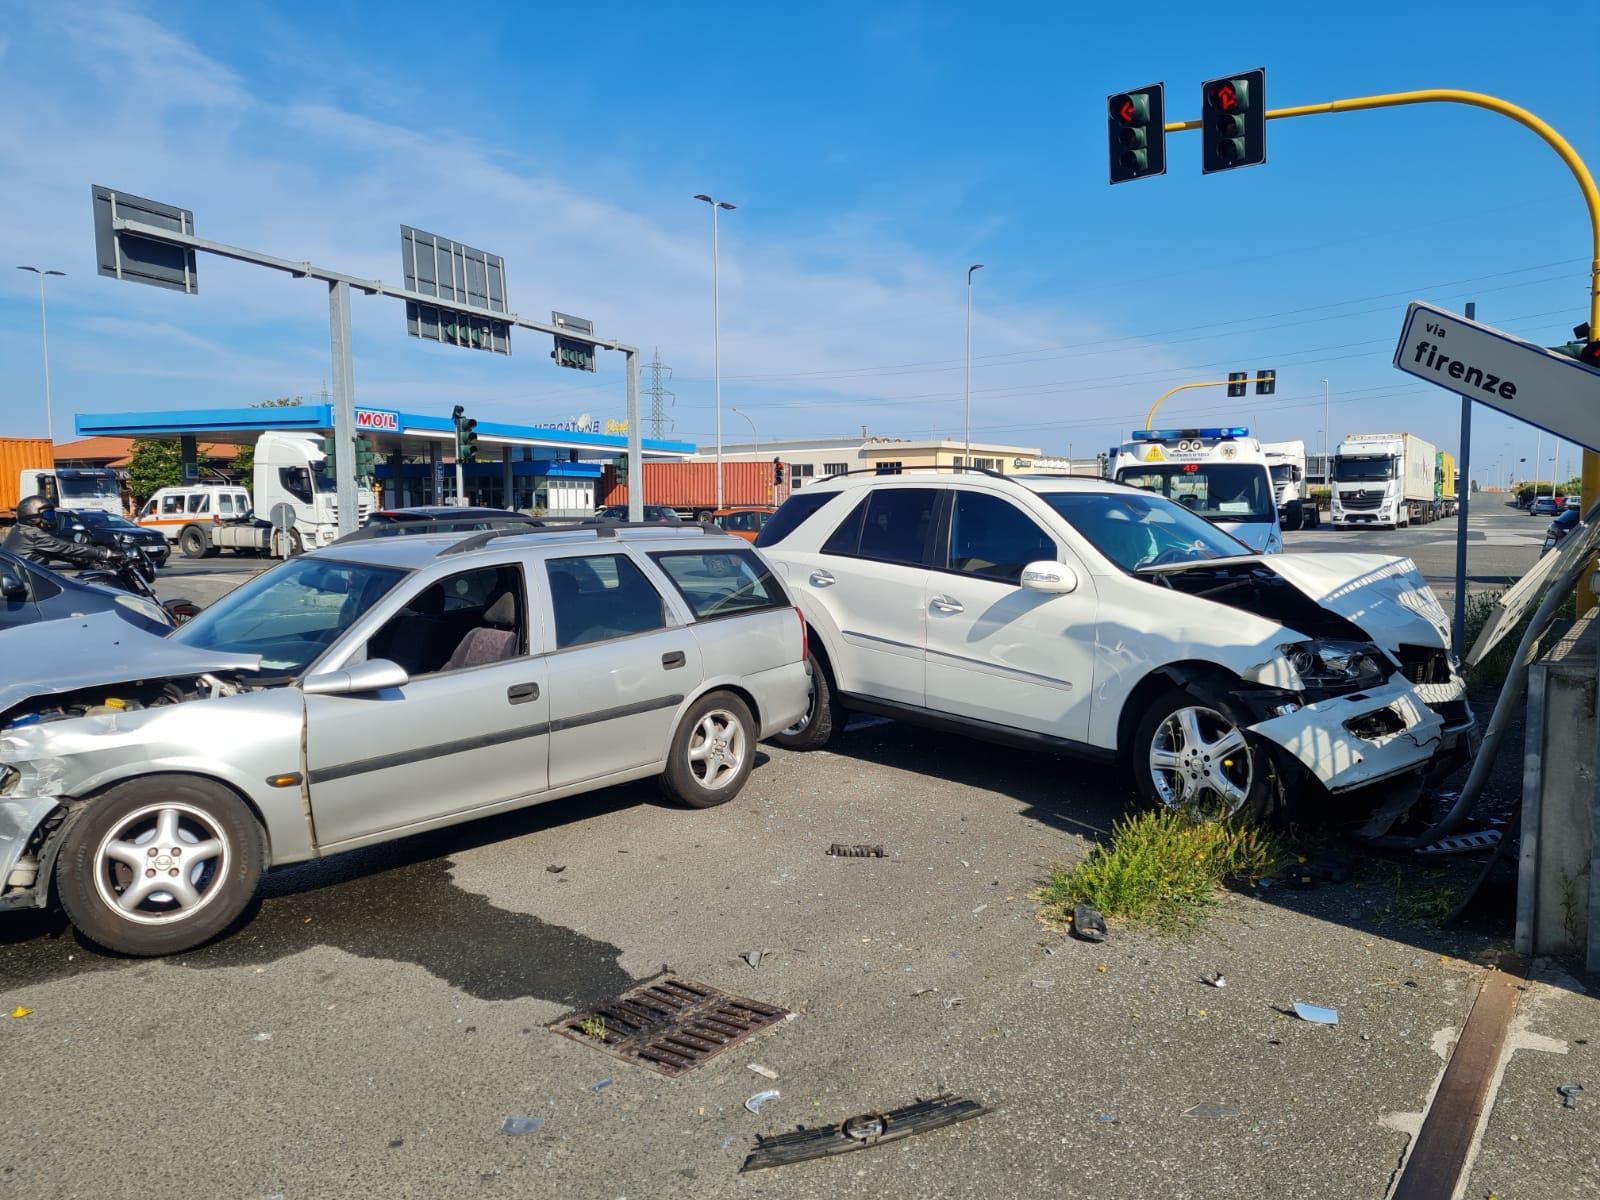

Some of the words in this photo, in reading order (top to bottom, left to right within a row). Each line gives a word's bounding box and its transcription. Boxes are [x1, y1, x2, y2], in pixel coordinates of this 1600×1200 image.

[1426, 323, 1447, 338] via
[1414, 341, 1517, 400] firenze
[1183, 464, 1199, 473] 49
